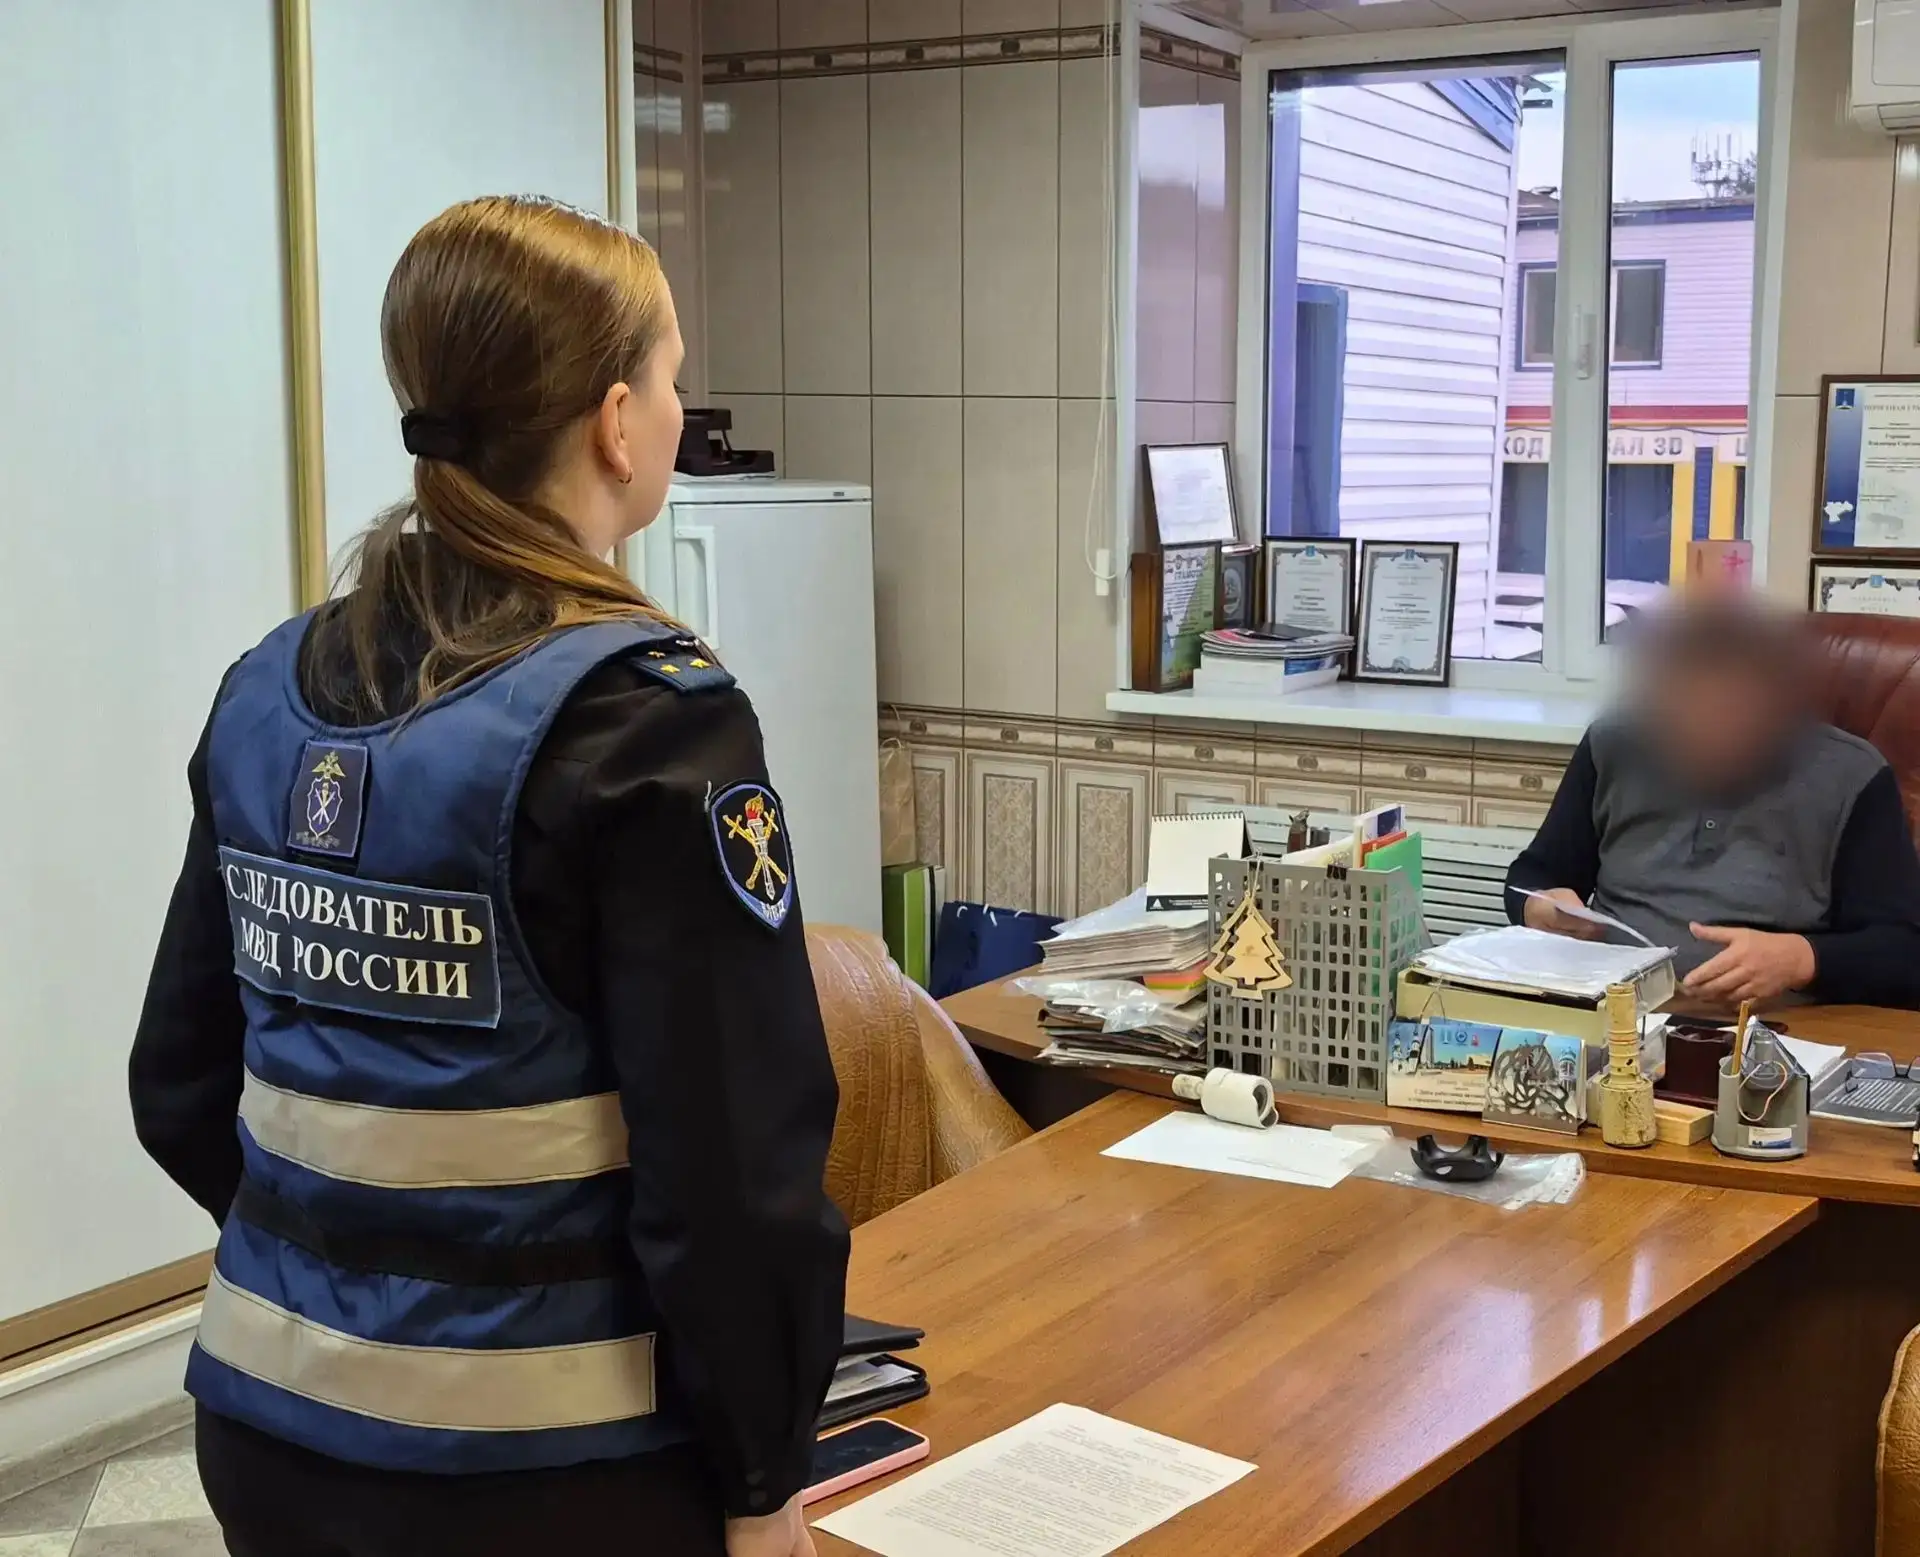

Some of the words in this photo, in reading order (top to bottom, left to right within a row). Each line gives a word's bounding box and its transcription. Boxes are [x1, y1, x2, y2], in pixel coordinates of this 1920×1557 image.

[1608, 436, 1645, 456] АЛ
[1653, 436, 1683, 456] 3D
[226, 864, 483, 946] СЛЕДОВАТЕЛЬ
[240, 917, 282, 978] МВД
[292, 935, 472, 999] РОССИИ
